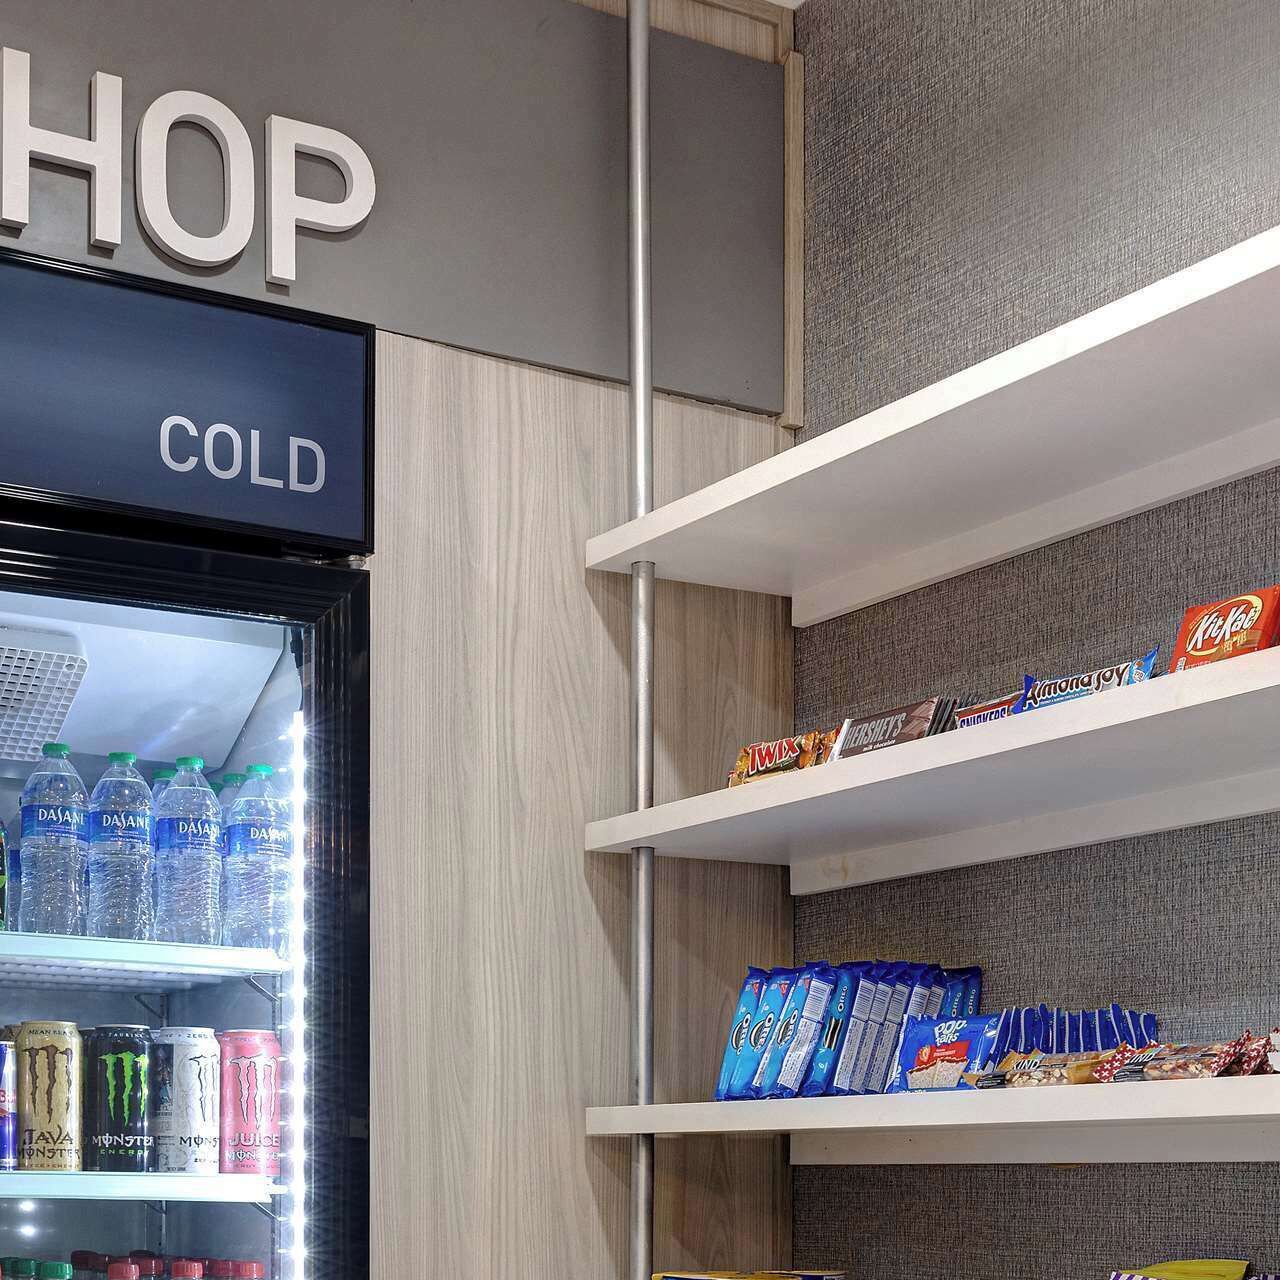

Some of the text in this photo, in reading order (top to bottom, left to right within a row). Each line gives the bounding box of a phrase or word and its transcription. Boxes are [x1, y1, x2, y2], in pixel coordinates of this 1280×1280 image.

[159, 415, 326, 494] COLD
[845, 713, 907, 749] HERSHEY'S
[748, 737, 800, 774] TWIX
[38, 808, 84, 824] DASANI
[103, 814, 149, 829] DASANI
[179, 821, 220, 835] DASANI
[838, 986, 848, 1012] OREO
[952, 992, 962, 1016] OREO
[23, 1125, 73, 1145] JAVA
[92, 1135, 154, 1147] MONSTER
